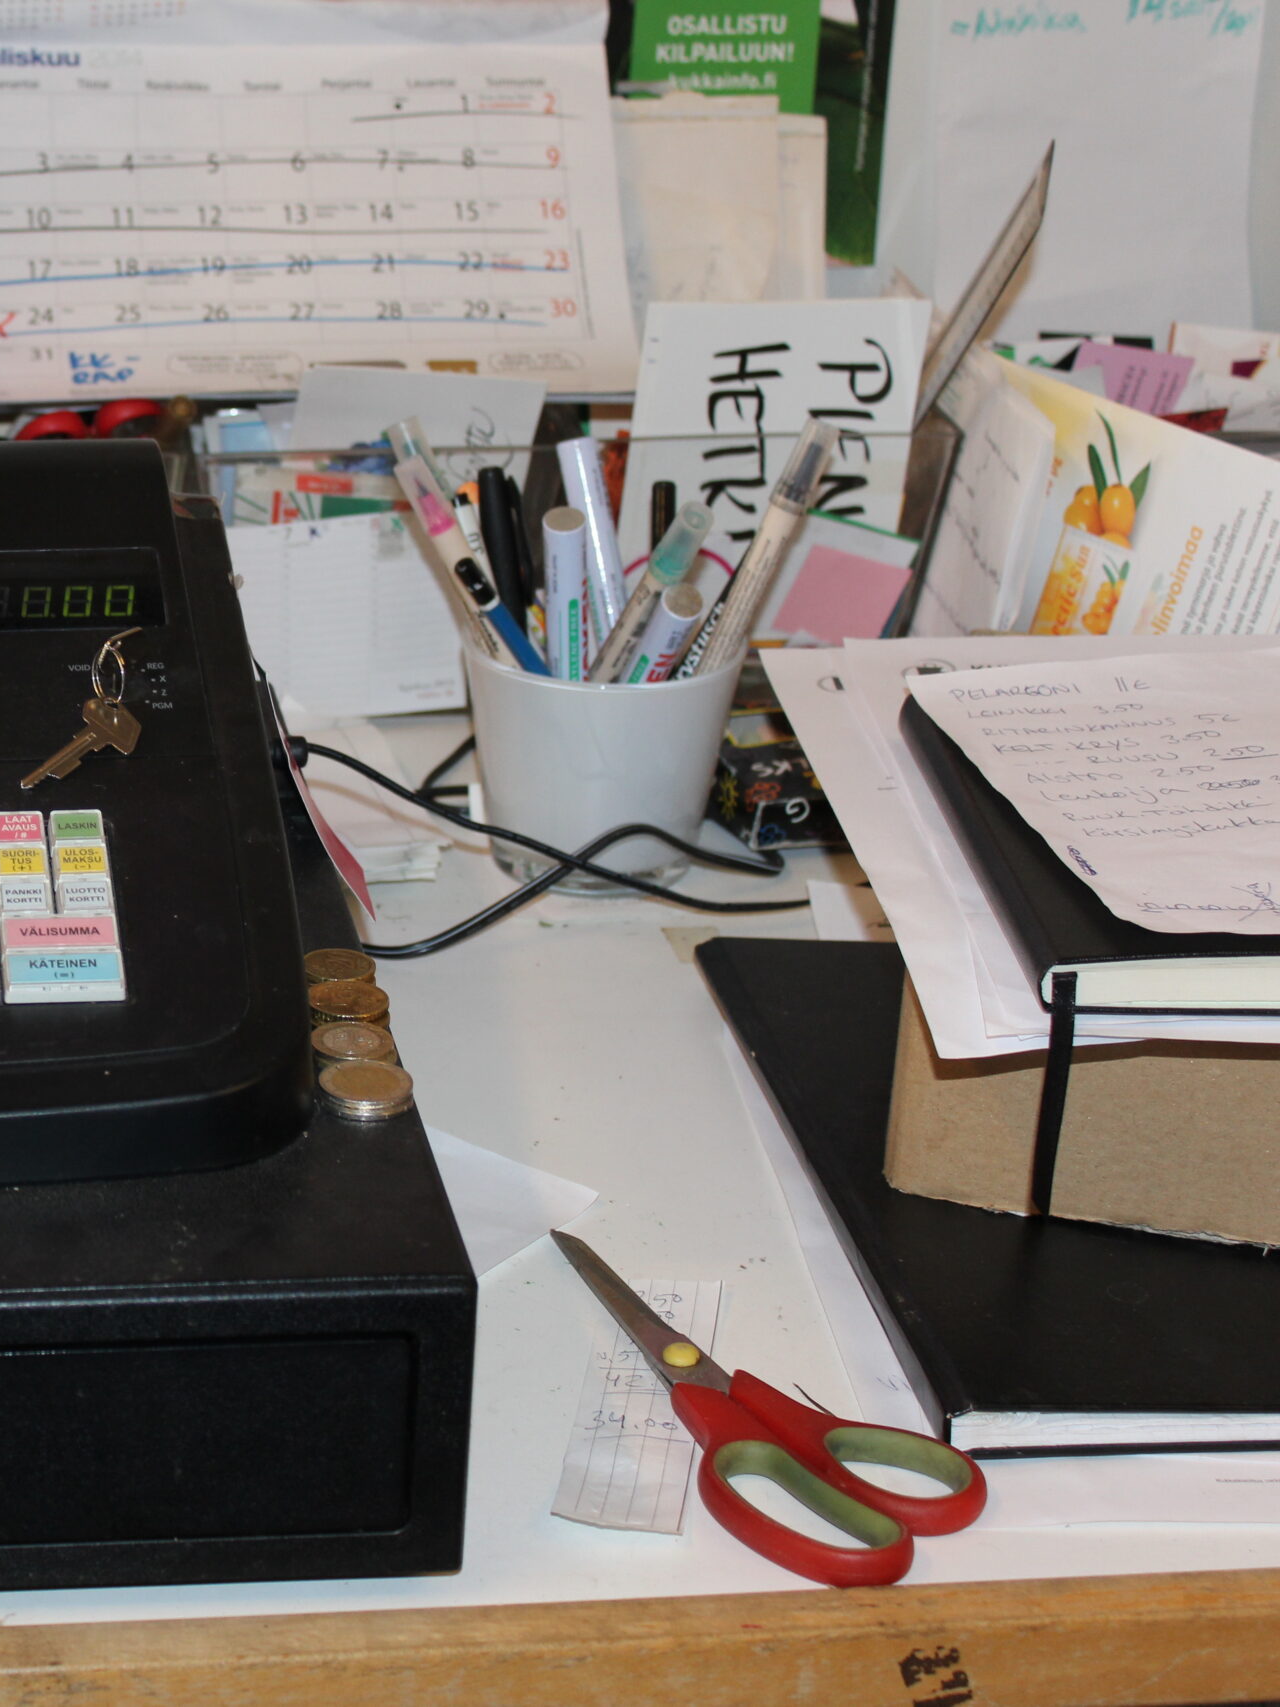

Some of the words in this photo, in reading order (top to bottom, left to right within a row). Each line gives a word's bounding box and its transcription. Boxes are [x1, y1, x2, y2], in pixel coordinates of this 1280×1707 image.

[667, 15, 787, 35] OSALLISTU
[655, 43, 795, 63] KILPAILUUN!
[460, 94, 470, 113] 1
[543, 93, 556, 115] 2
[38, 153, 49, 172] 3
[123, 154, 135, 173] 4
[207, 154, 219, 173] 5
[291, 152, 305, 173] 6
[377, 150, 389, 170] 7
[461, 148, 475, 168] 8
[546, 148, 560, 168] 9
[26, 207, 52, 229] 10
[112, 208, 135, 228] 11
[198, 207, 221, 226] 12
[285, 204, 308, 224] 13
[370, 203, 393, 222] 14
[456, 202, 479, 222] 15
[541, 201, 565, 220] 16
[28, 260, 52, 280] 17
[114, 259, 139, 278] 18
[201, 257, 225, 276] 19
[286, 255, 312, 274] 20
[372, 255, 395, 273] 21
[459, 253, 483, 272] 22
[544, 251, 569, 271] 23
[28, 307, 53, 325] 24
[115, 306, 140, 323] 25
[203, 306, 228, 323] 26
[290, 304, 314, 320] 27
[377, 303, 402, 320] 28
[463, 301, 489, 318] 29
[551, 301, 576, 317] 30
[30, 348, 53, 362] 31
[5, 815, 33, 823] LAAT
[1, 823, 37, 831] AVAUS
[58, 822, 97, 830] LASKIN
[5, 888, 42, 896] PANKKI
[66, 887, 105, 895] LUOTTO
[7, 896, 42, 904] KORTTI
[69, 895, 104, 903] KORTTI
[20, 924, 101, 937] VÄLISUMMA
[29, 957, 97, 969] KÄTEINEN
